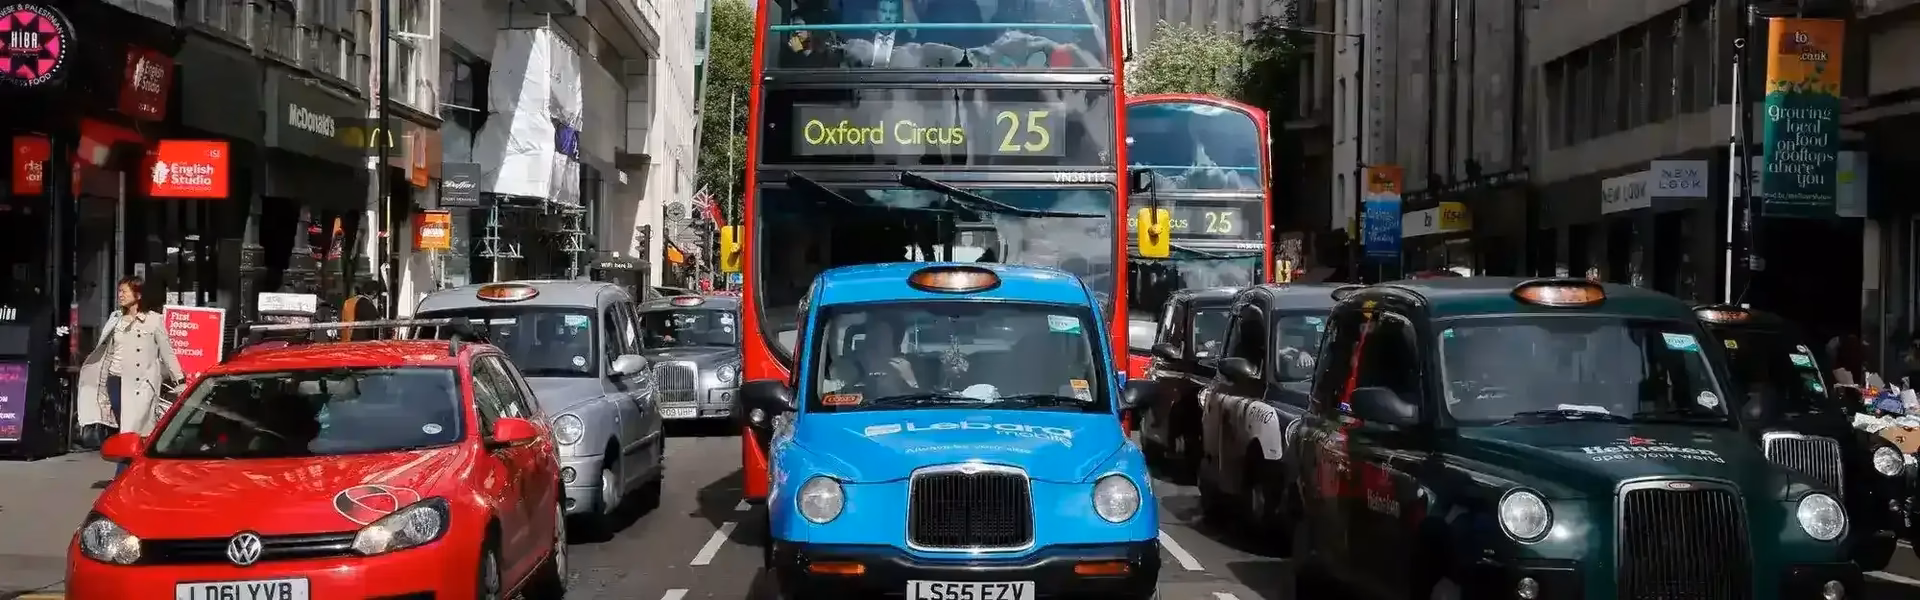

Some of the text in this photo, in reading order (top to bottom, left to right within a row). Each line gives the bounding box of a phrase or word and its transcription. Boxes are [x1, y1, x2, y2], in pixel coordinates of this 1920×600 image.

[25, 4, 64, 34] PALESTINIAN
[1795, 31, 1808, 43] to
[28, 72, 51, 87] FOOD
[1767, 104, 1832, 121] growing
[288, 103, 335, 138] McDonald's
[1786, 119, 1821, 133] local
[804, 110, 1051, 152] Oxford Circus 25
[1777, 140, 1796, 151] on
[1795, 132, 1828, 147] food
[1775, 147, 1835, 167] rooftops
[171, 162, 215, 178] English
[1661, 169, 1698, 179] NEW
[1768, 160, 1815, 174] above
[171, 174, 213, 185] Studio
[1658, 179, 1701, 189] LOOK
[1797, 173, 1825, 189] you
[1602, 180, 1648, 204] NEW LOOK
[1205, 211, 1233, 234] 25
[171, 311, 190, 321] First
[169, 328, 188, 337] free
[170, 320, 199, 330] lesson
[905, 420, 1074, 440] Lebara
[995, 430, 1074, 450] mobile
[1582, 444, 1719, 457] Heineken
[1591, 451, 1726, 464] open your world
[915, 582, 974, 600] LS55
